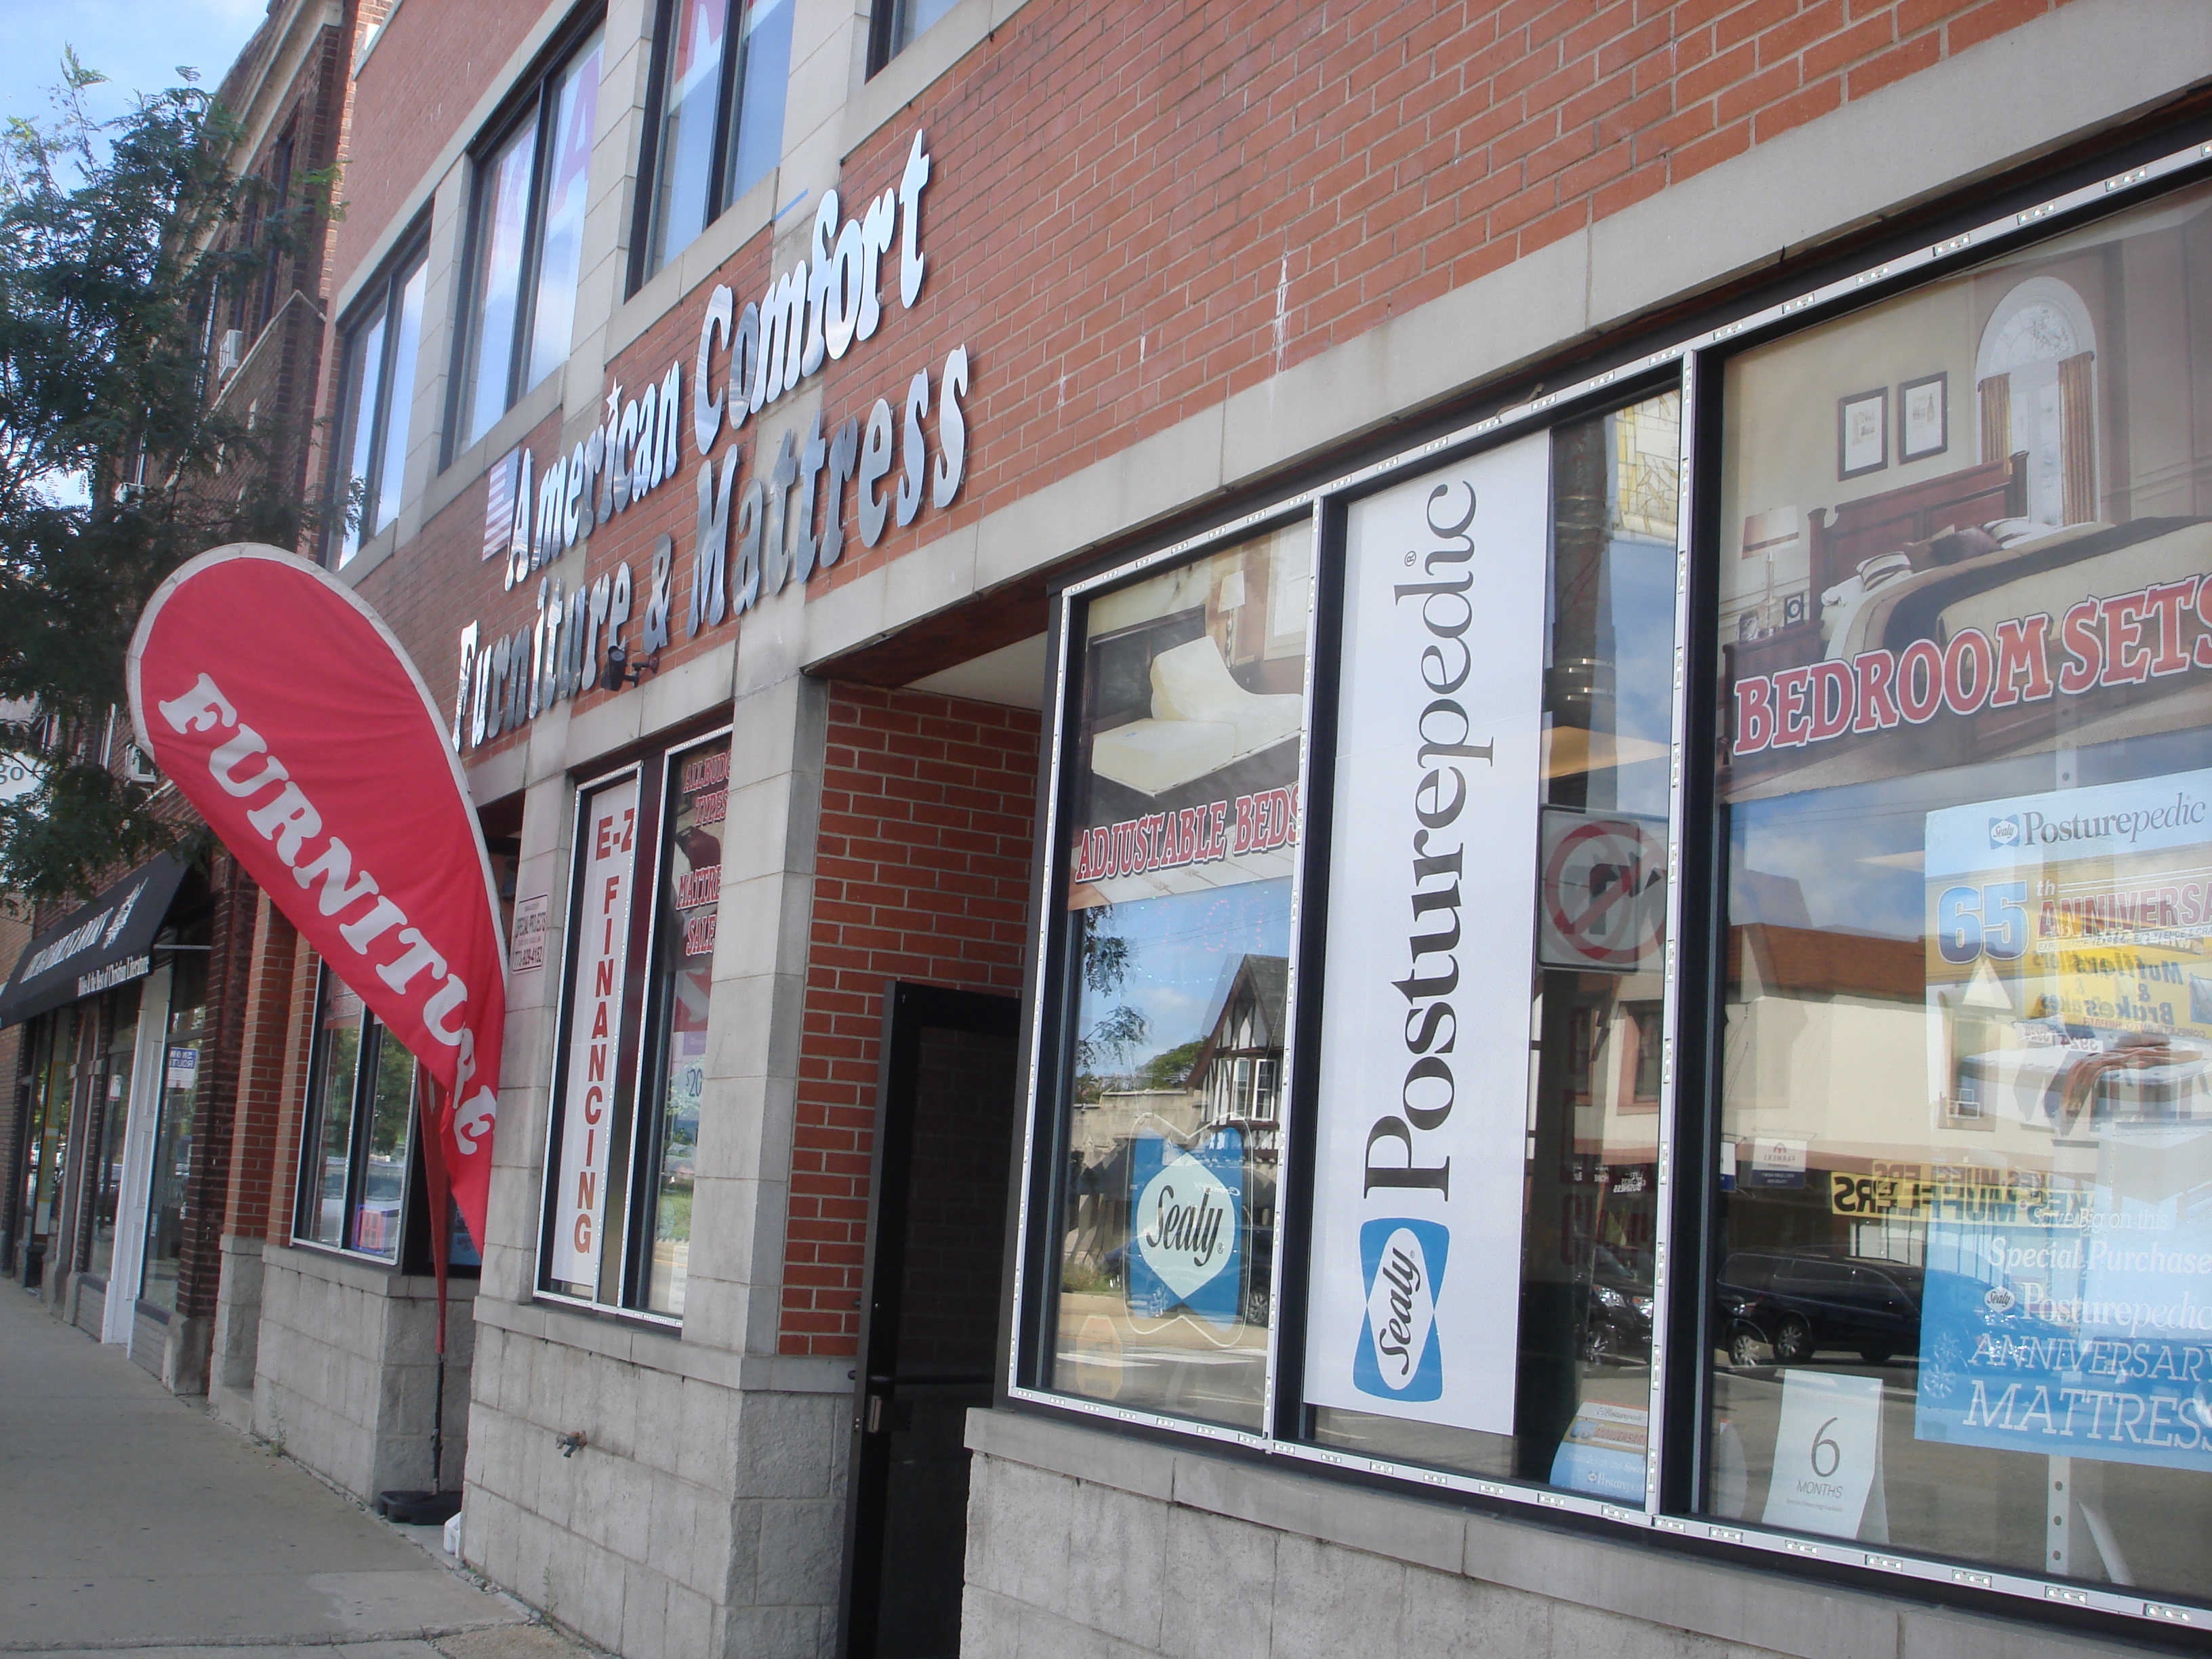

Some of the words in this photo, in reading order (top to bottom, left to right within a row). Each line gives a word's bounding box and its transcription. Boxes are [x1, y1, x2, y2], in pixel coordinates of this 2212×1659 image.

[504, 361, 680, 592] American
[693, 129, 930, 455] Comfort
[452, 561, 632, 752] Furniture
[642, 533, 674, 655] &
[687, 344, 968, 638] Mattress
[1733, 611, 2054, 756] BEDROOM
[682, 760, 703, 794] ALL
[695, 788, 729, 827] TYPES
[1992, 822, 2015, 840] Sealy
[2023, 792, 2206, 845] Posturepedic
[1075, 800, 1227, 882] ADJUSTABLE
[1364, 480, 1494, 1202] Posturepedic
[686, 914, 717, 956] SALE
[573, 876, 619, 1254] FINANCING
[1146, 1184, 1224, 1267] Sealy
[2032, 1208, 2075, 1228] Save
[2079, 1208, 2105, 1233] Big
[1988, 1236, 2080, 1271] Special
[2087, 1240, 2212, 1275] Purchase
[1374, 1246, 1421, 1376] Sealy
[1986, 1290, 2011, 1307] Sealy
[2018, 1280, 2212, 1338] Posturepedic
[1811, 1417, 1841, 1477] 6
[1796, 1479, 1844, 1499] MONTHS
